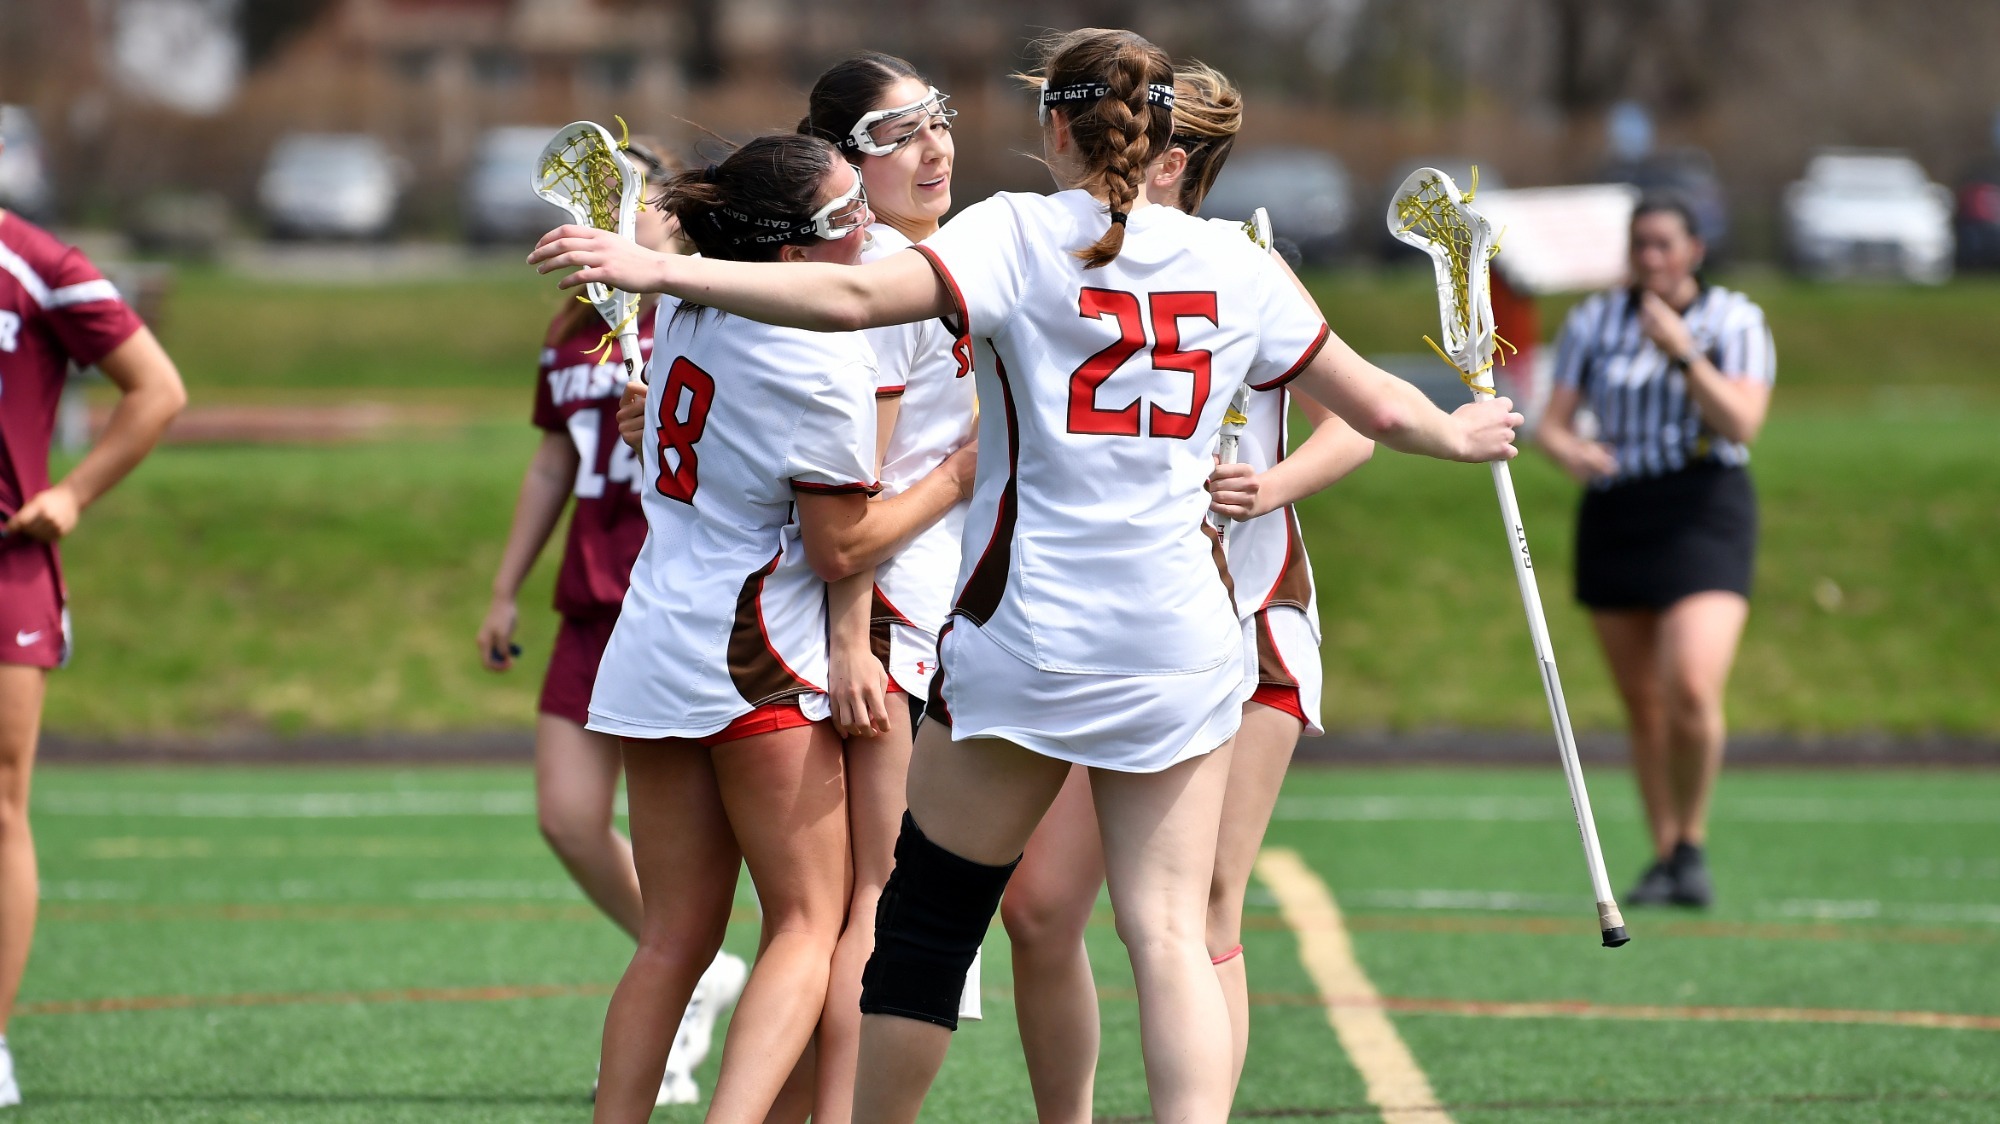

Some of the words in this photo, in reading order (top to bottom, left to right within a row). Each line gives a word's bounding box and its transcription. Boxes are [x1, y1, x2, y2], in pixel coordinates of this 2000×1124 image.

[1045, 91, 1061, 101] GAIT
[1064, 89, 1088, 100] GAIT
[755, 217, 791, 229] GAIT
[756, 231, 792, 243] GAIT
[1067, 286, 1219, 440] 25
[567, 408, 643, 498] 14
[656, 355, 715, 506] 8
[1515, 524, 1531, 569] GAIT
